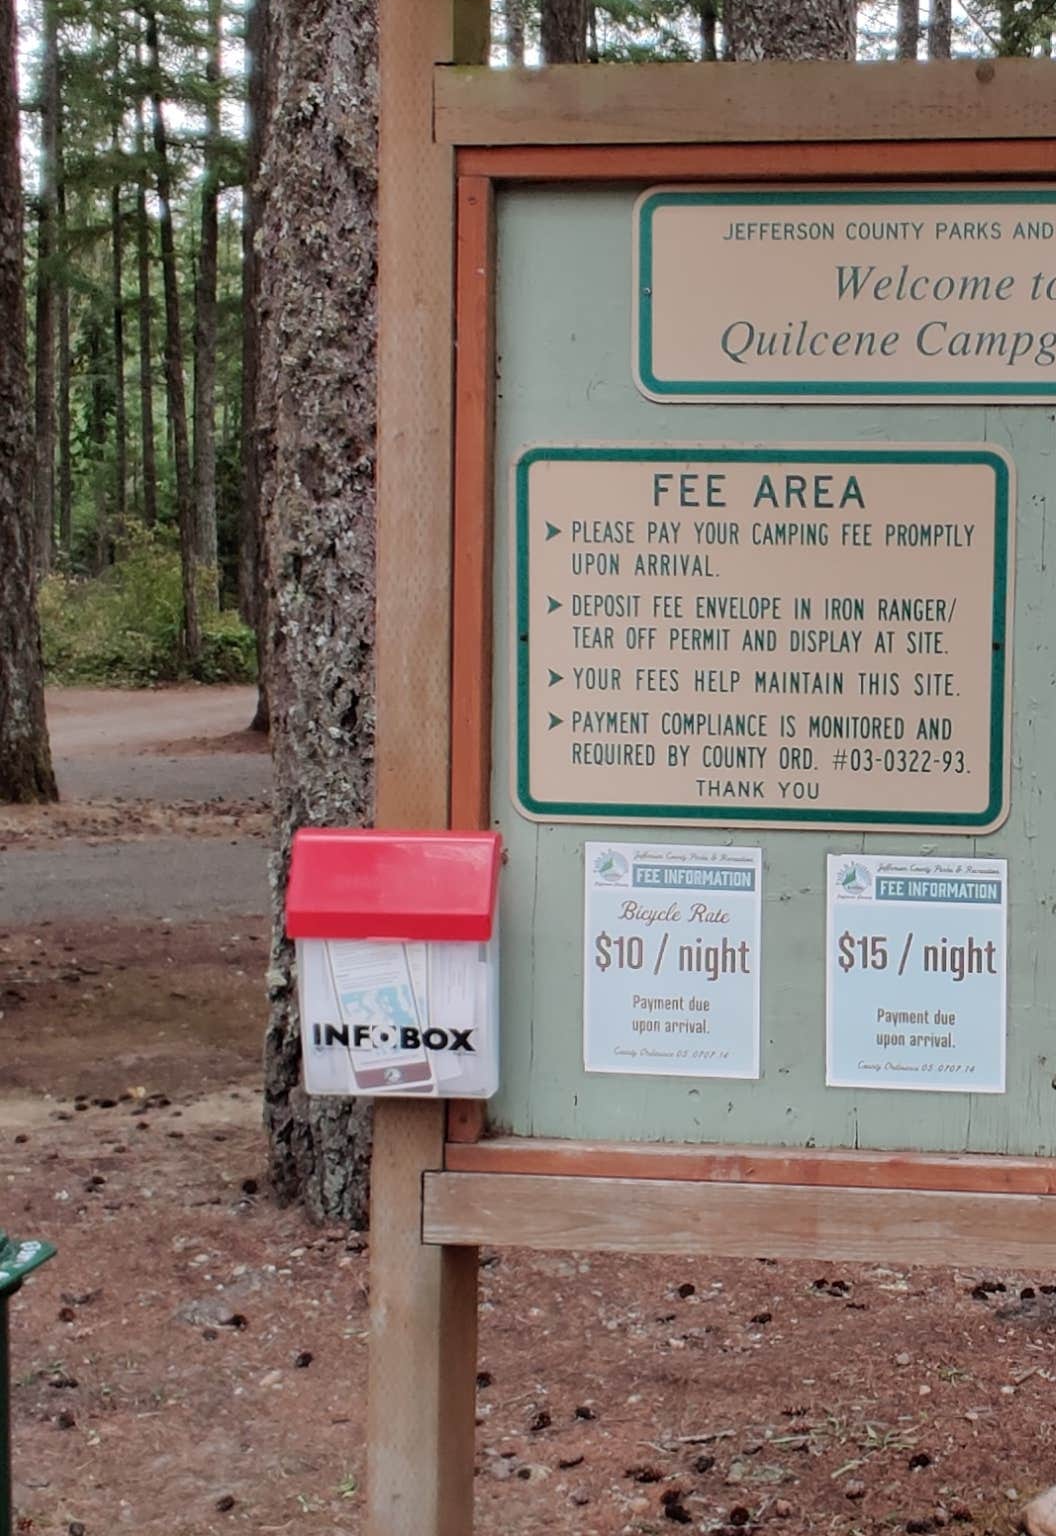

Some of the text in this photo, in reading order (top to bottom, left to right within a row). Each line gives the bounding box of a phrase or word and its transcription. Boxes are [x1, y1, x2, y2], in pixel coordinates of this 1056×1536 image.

[722, 221, 835, 241] JEFFERSON
[845, 221, 925, 240] COUNTY
[935, 221, 1002, 240] PARKS
[1012, 221, 1055, 240] AND
[833, 264, 1015, 302] Welcome
[719, 319, 899, 365] Quilcene
[653, 472, 867, 510] FEE AREA
[572, 521, 976, 548] PLEASE PAY YOUR CAMPING FEE PROMPTLY
[572, 553, 721, 578] UPON ARRIVAL.
[572, 594, 957, 623] DEPOSIT FEE ENVELOPE IN IRON RANGER/
[572, 626, 950, 655] TEAR OFF PERMIT AND DISPLAY AT SITE.
[572, 667, 962, 698] YOUR FEES HELP MAINTAIN THIS SITE.
[572, 711, 953, 741] PAYMENT COMPLIANCE IS MONITORED AND
[572, 743, 972, 775] REQUIRED BY COUNTY ORD. #03-0322-93.
[695, 779, 820, 801] THANK YOU
[636, 868, 752, 887] FEE INFORMATION
[880, 879, 998, 899] FEE INFORMATION
[617, 899, 730, 928] Bicycle Rate
[594, 930, 751, 982] $10 / night
[838, 930, 998, 982] $15 / night
[632, 994, 710, 1014] Payment due
[876, 1007, 956, 1028] Payment due
[631, 1017, 710, 1036] upon arrival.
[876, 1030, 956, 1049] upon arrival.
